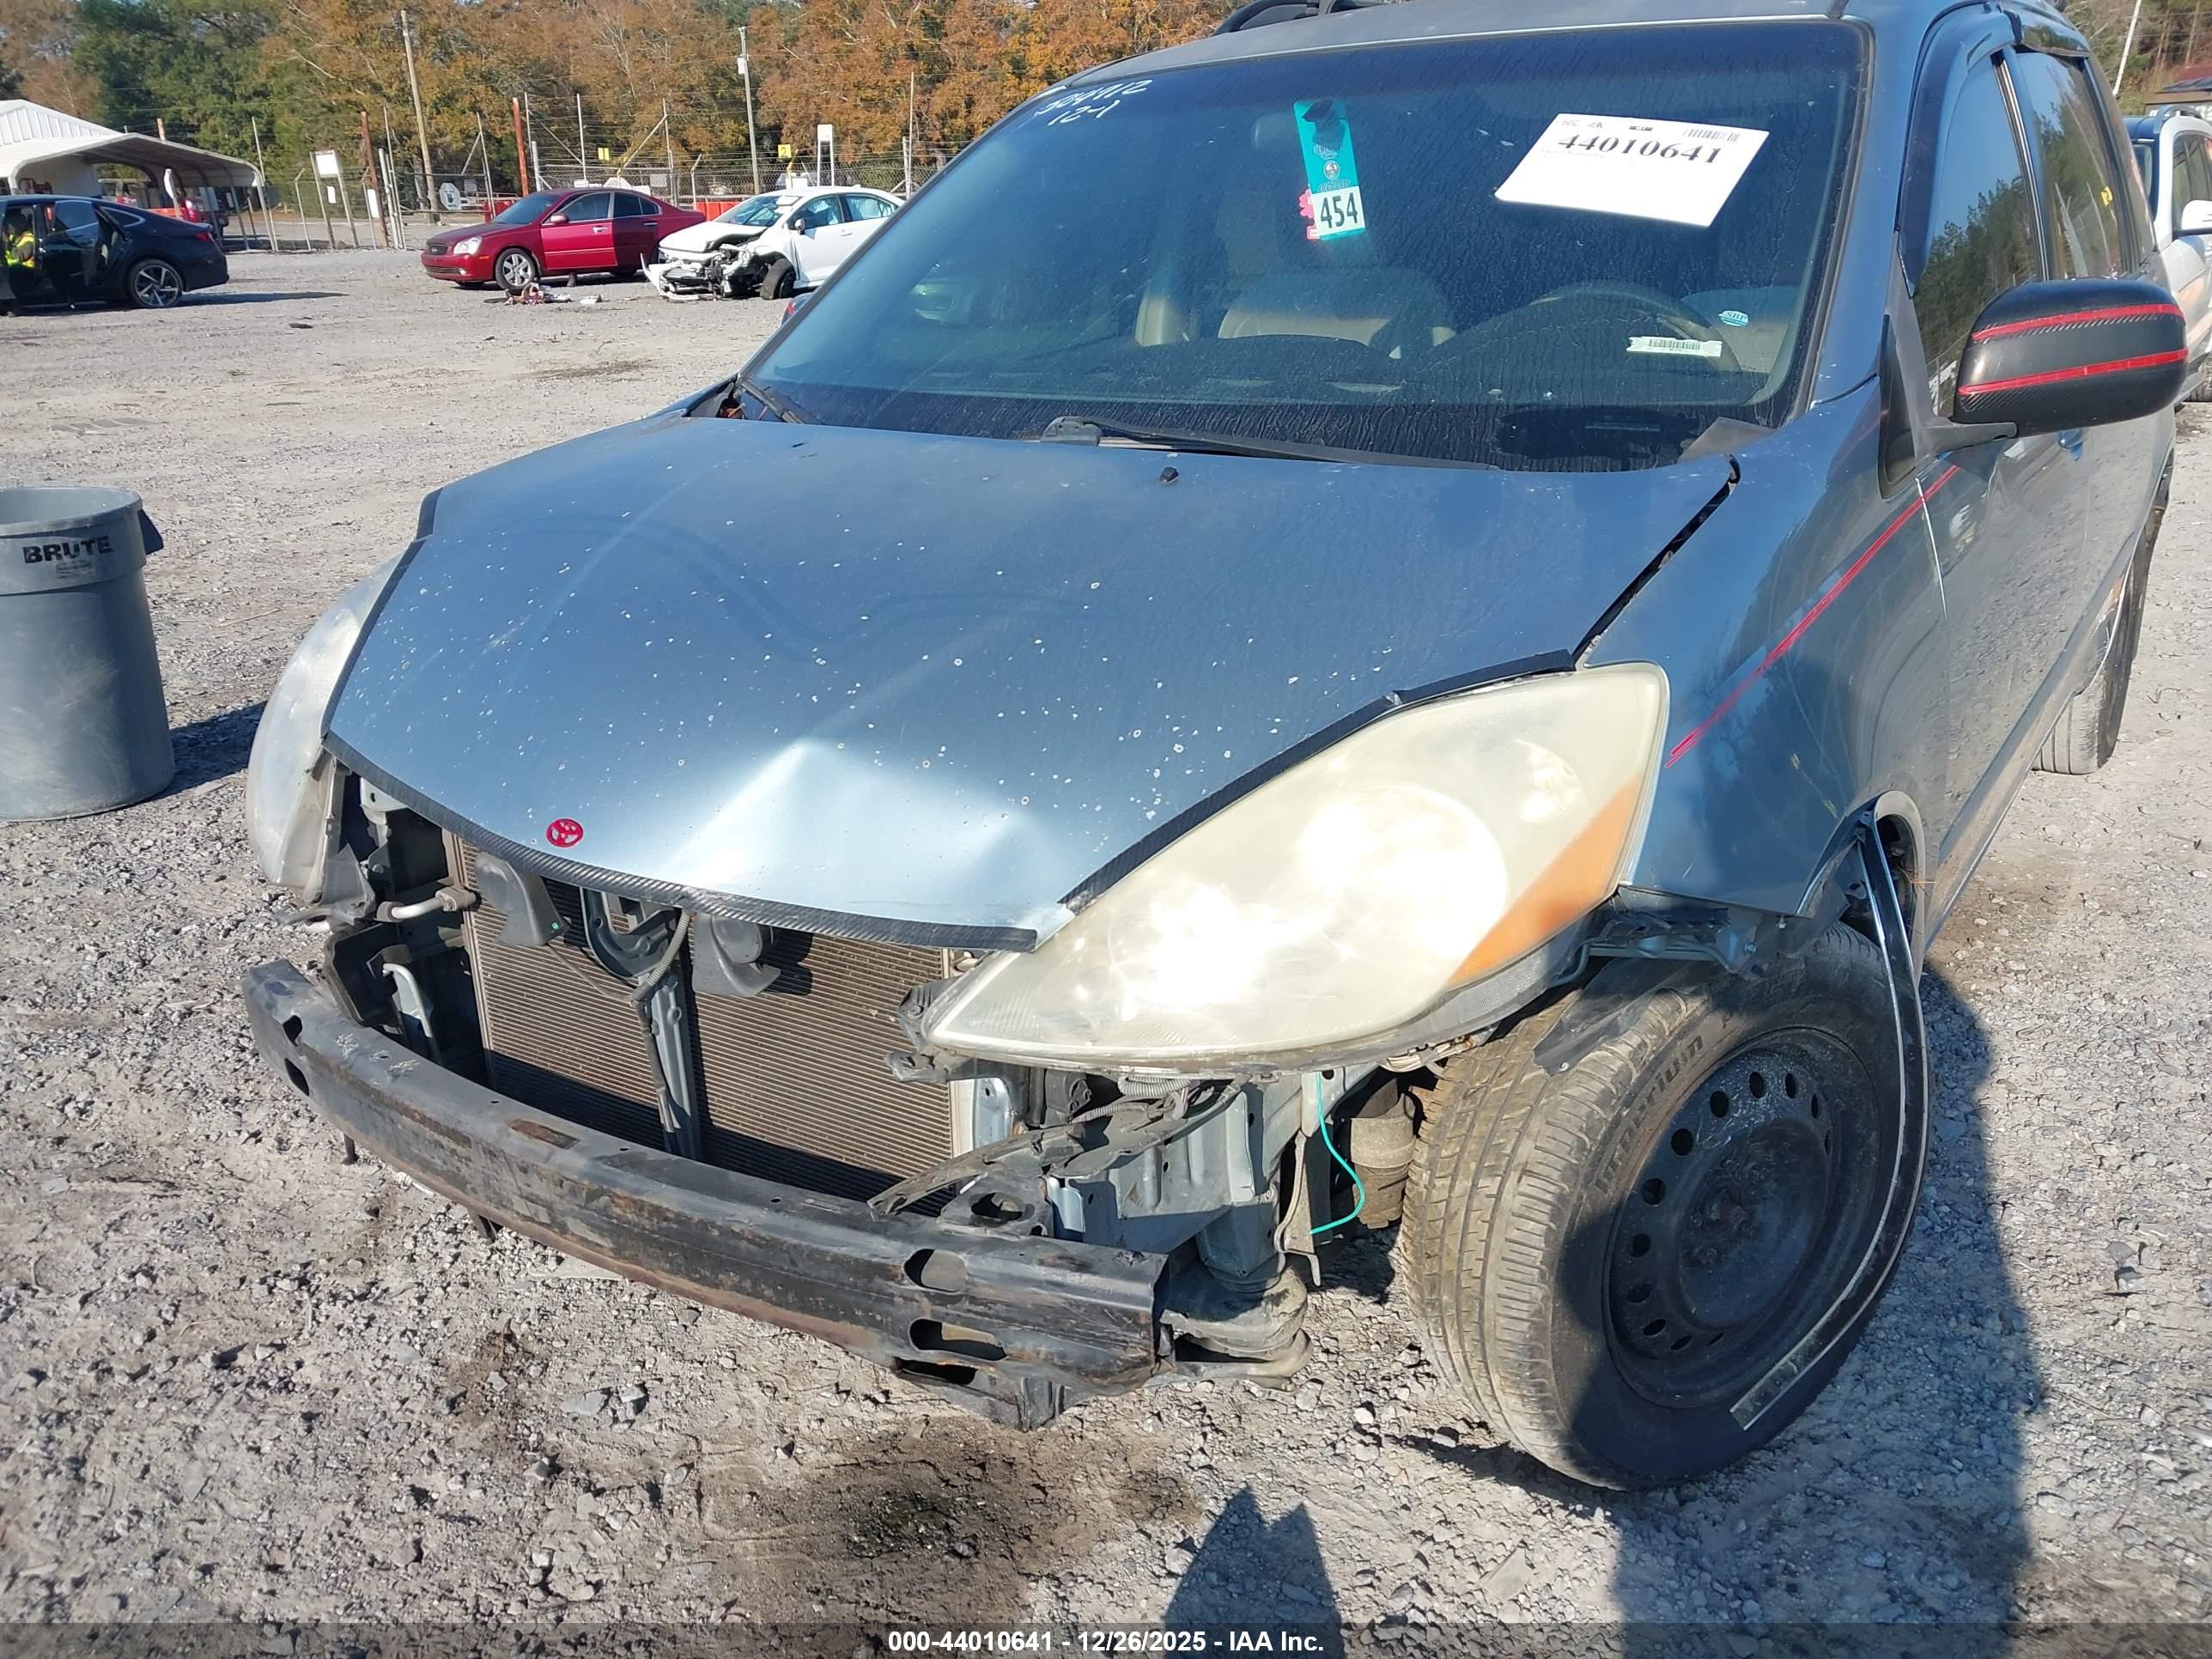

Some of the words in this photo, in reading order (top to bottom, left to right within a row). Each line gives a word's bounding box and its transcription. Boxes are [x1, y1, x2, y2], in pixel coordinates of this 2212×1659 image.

[1557, 134, 1721, 164] 44010641
[1320, 191, 1358, 229] 454
[22, 536, 113, 563] BRUTE
